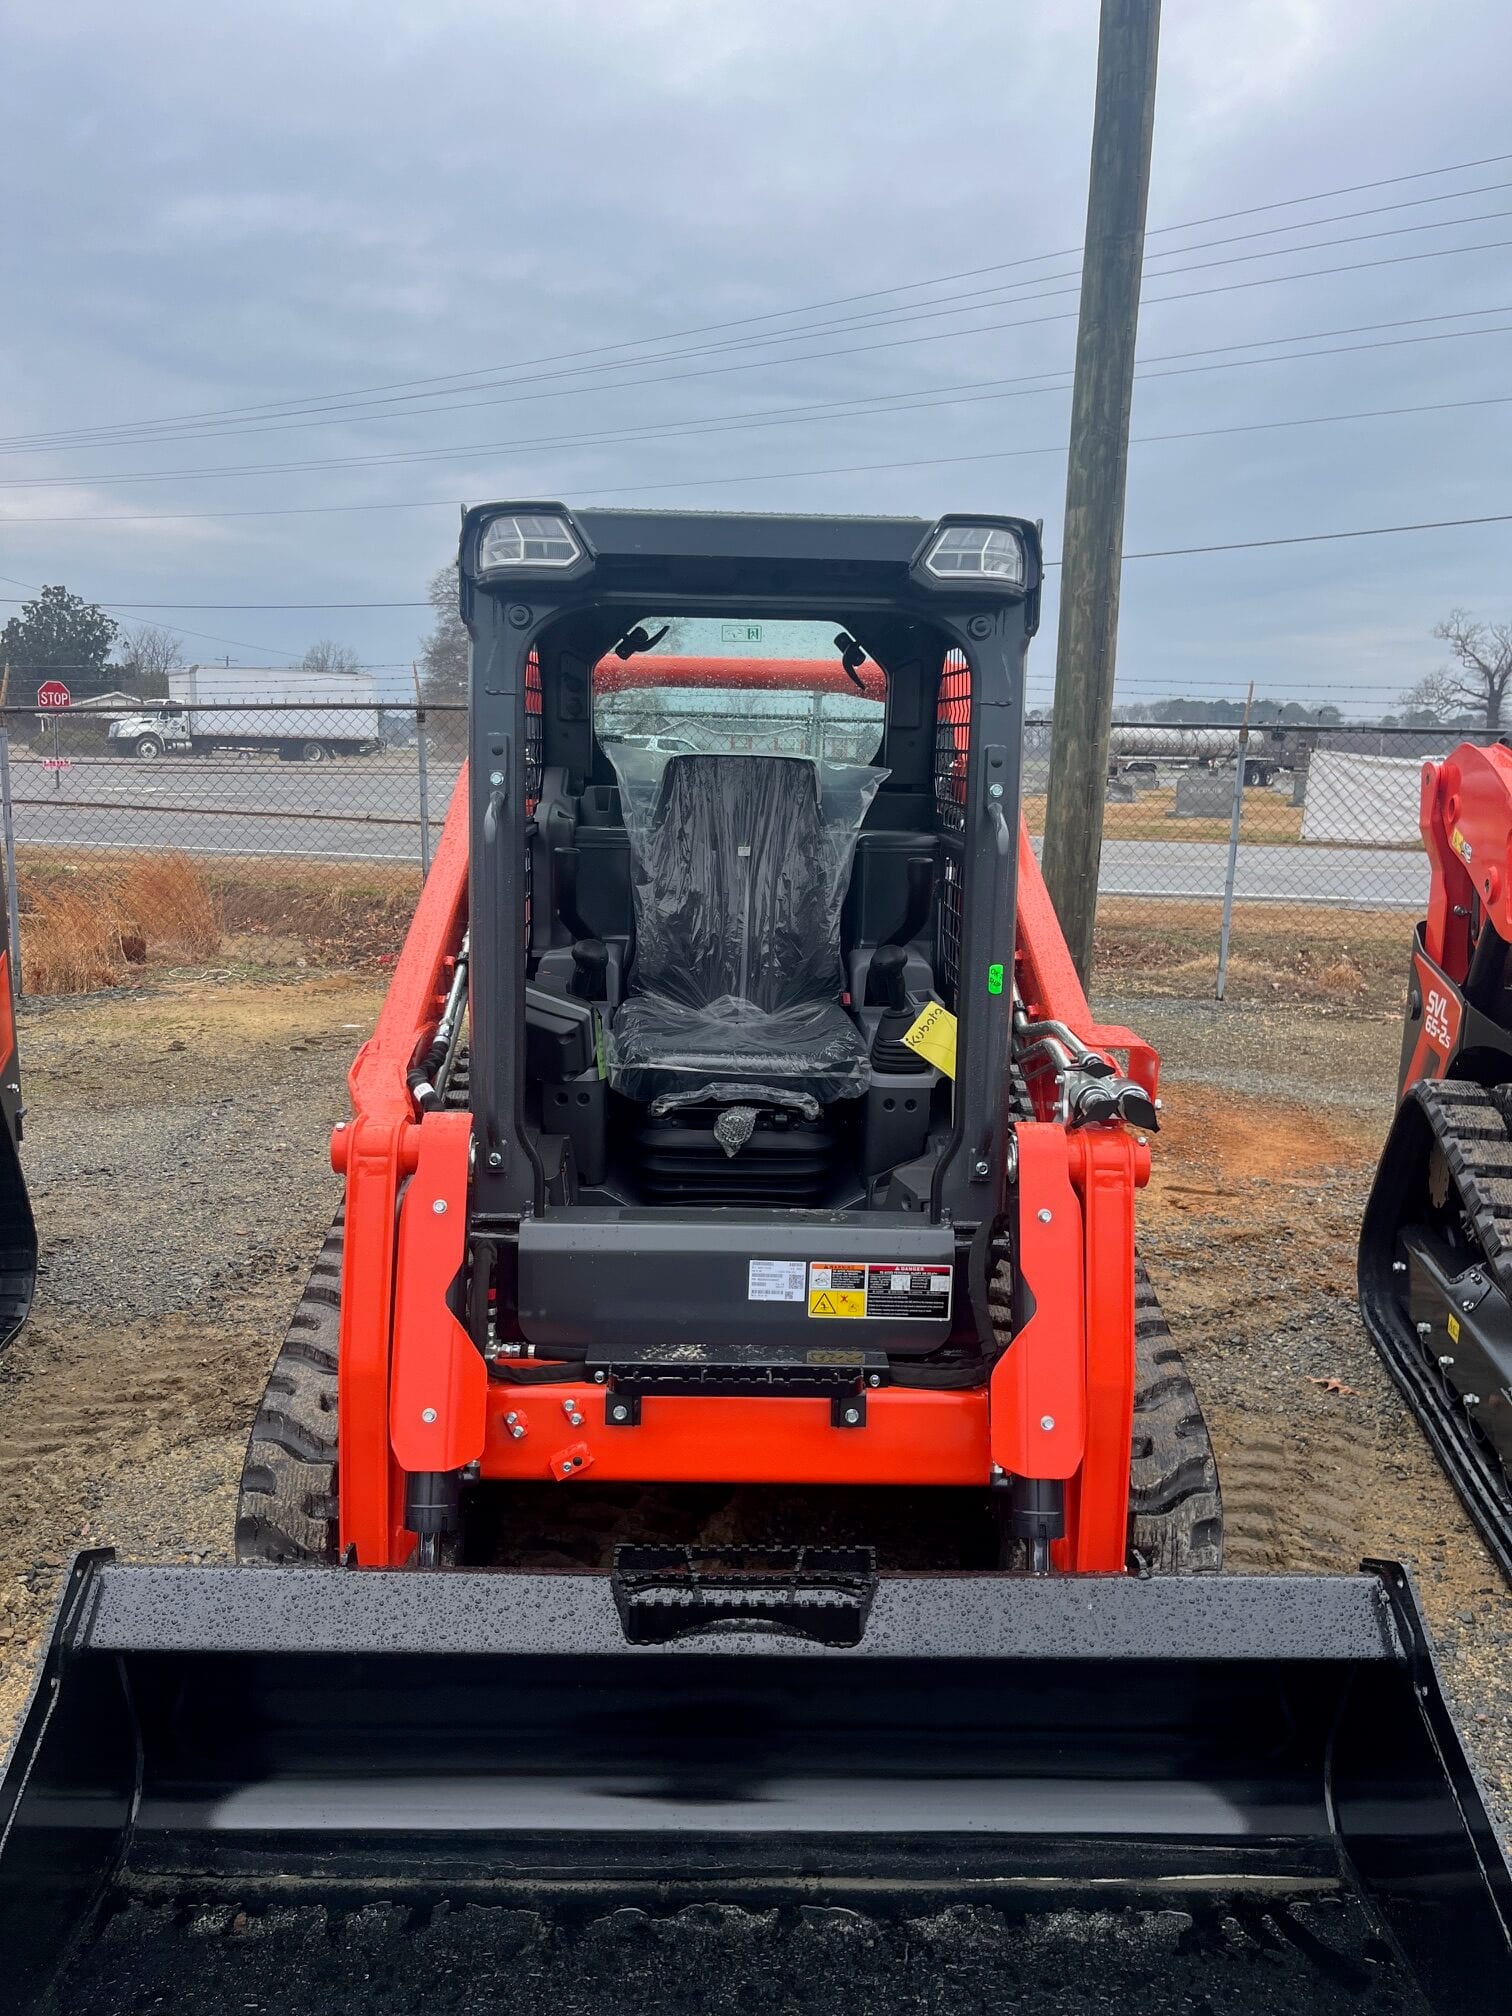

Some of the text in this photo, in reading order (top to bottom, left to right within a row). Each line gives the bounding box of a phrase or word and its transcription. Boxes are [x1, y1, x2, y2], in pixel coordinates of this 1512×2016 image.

[41, 692, 68, 705] STOP
[1425, 989, 1448, 1025] SVL
[905, 1008, 944, 1047] Kubota
